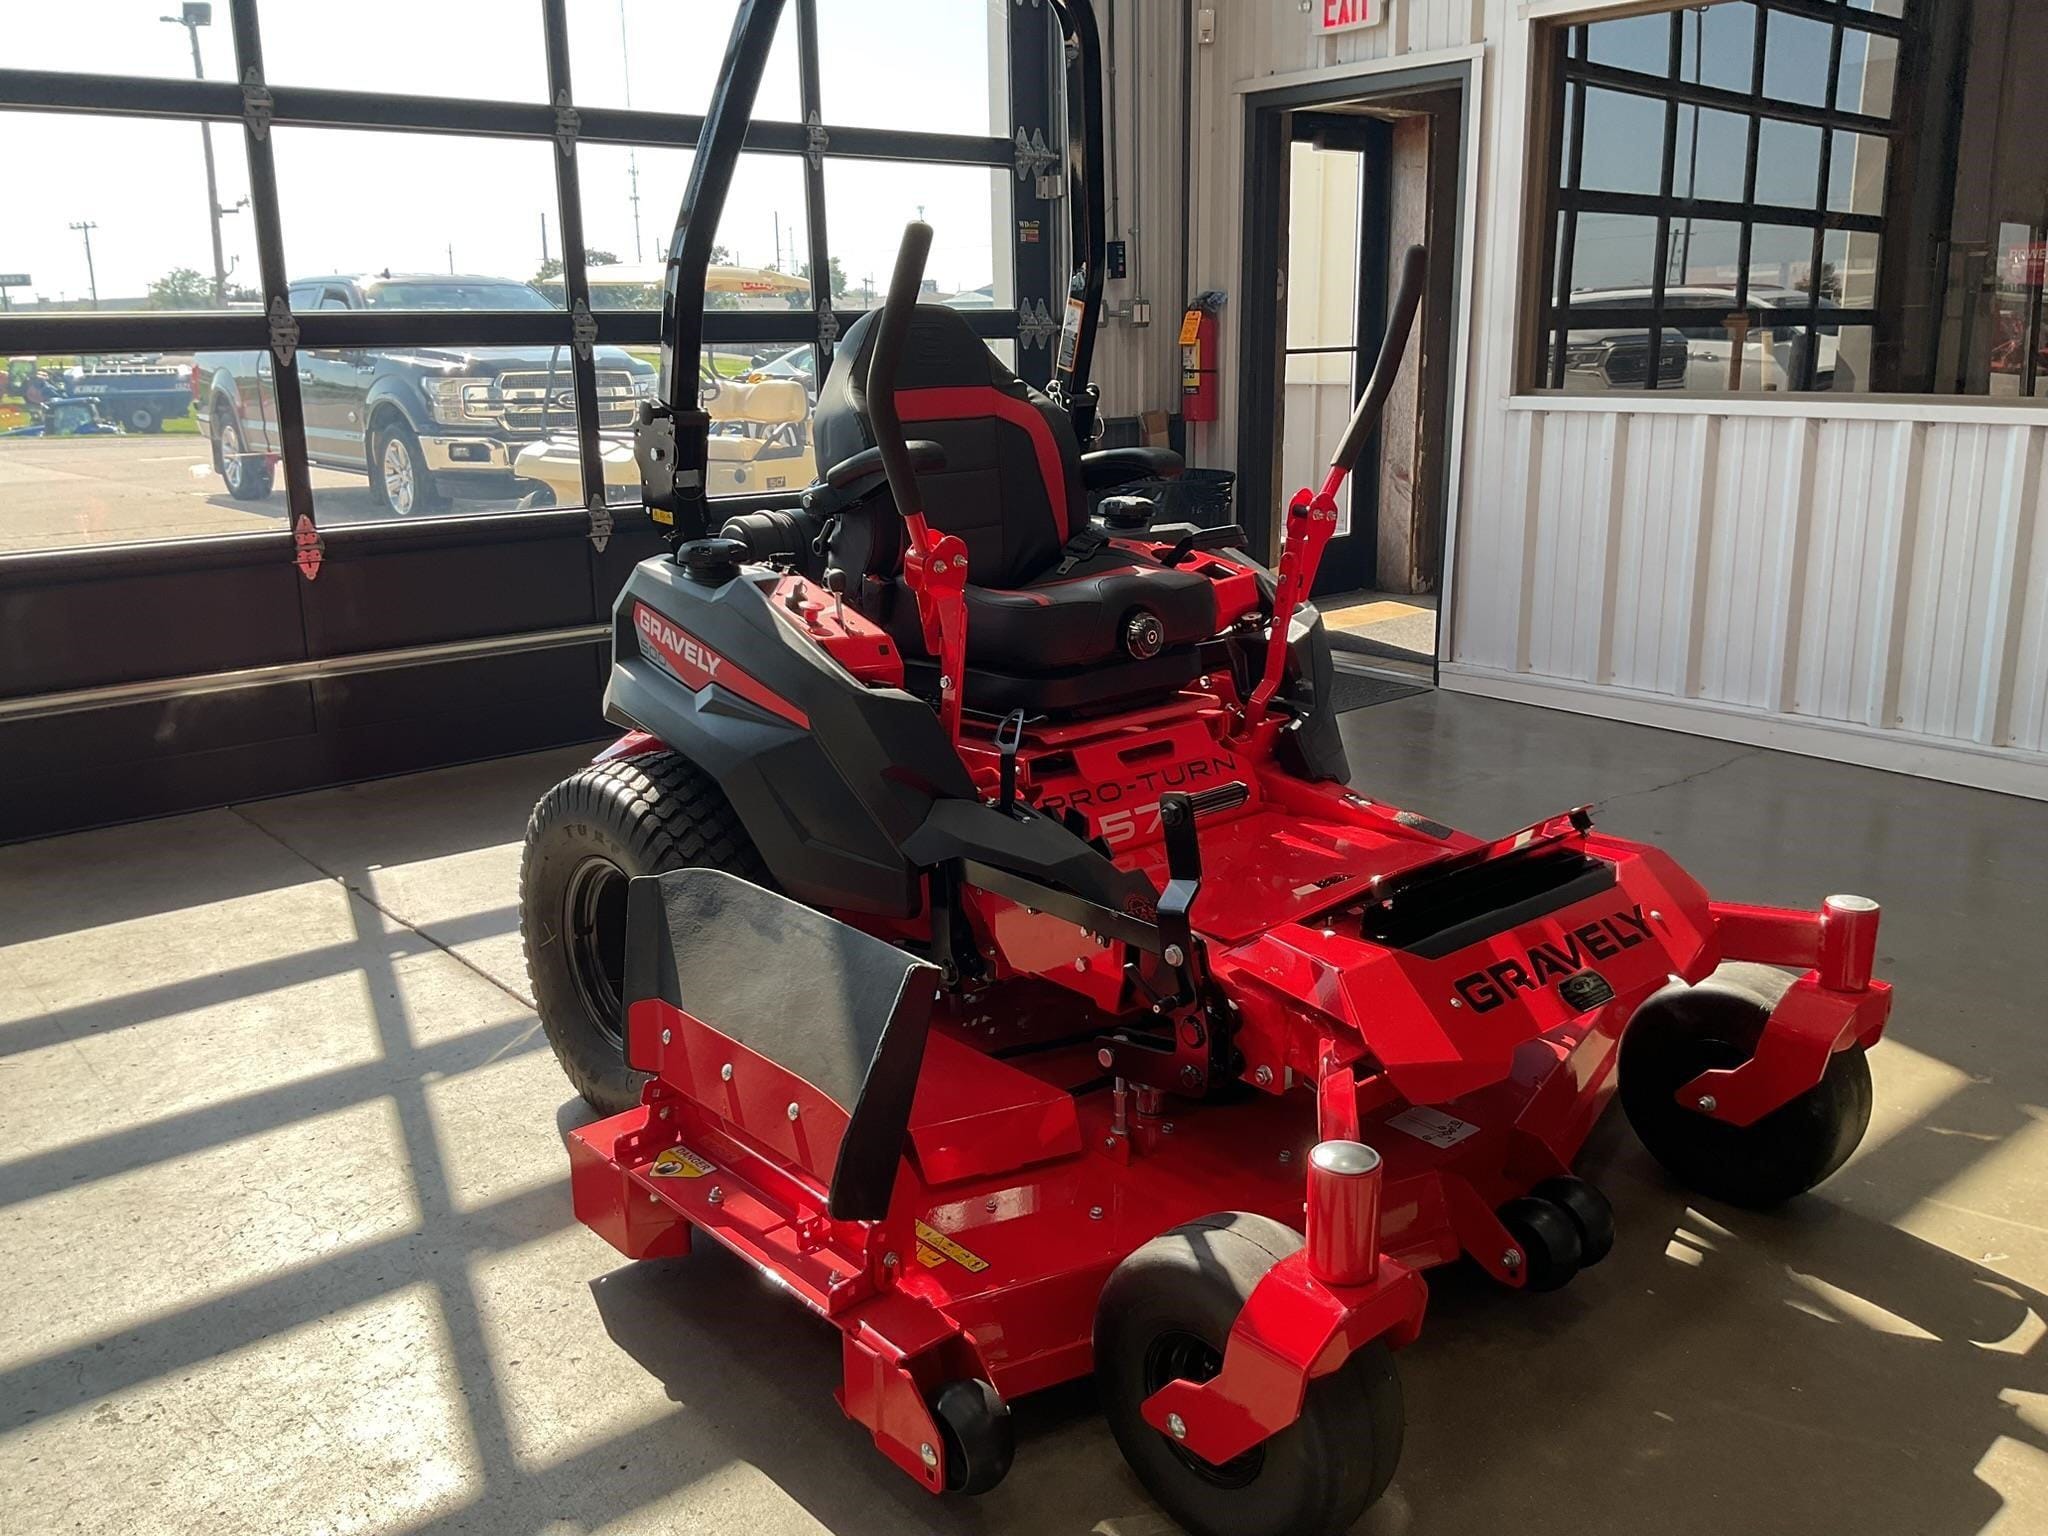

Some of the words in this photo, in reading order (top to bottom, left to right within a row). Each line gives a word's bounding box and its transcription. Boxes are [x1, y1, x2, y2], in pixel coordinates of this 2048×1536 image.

[74, 384, 109, 394] KINZE
[639, 608, 721, 676] GRAVELY
[1040, 754, 1237, 810] PRO-TURN
[1454, 903, 1654, 1014] GRAVELY
[675, 1147, 711, 1171] DANGER
